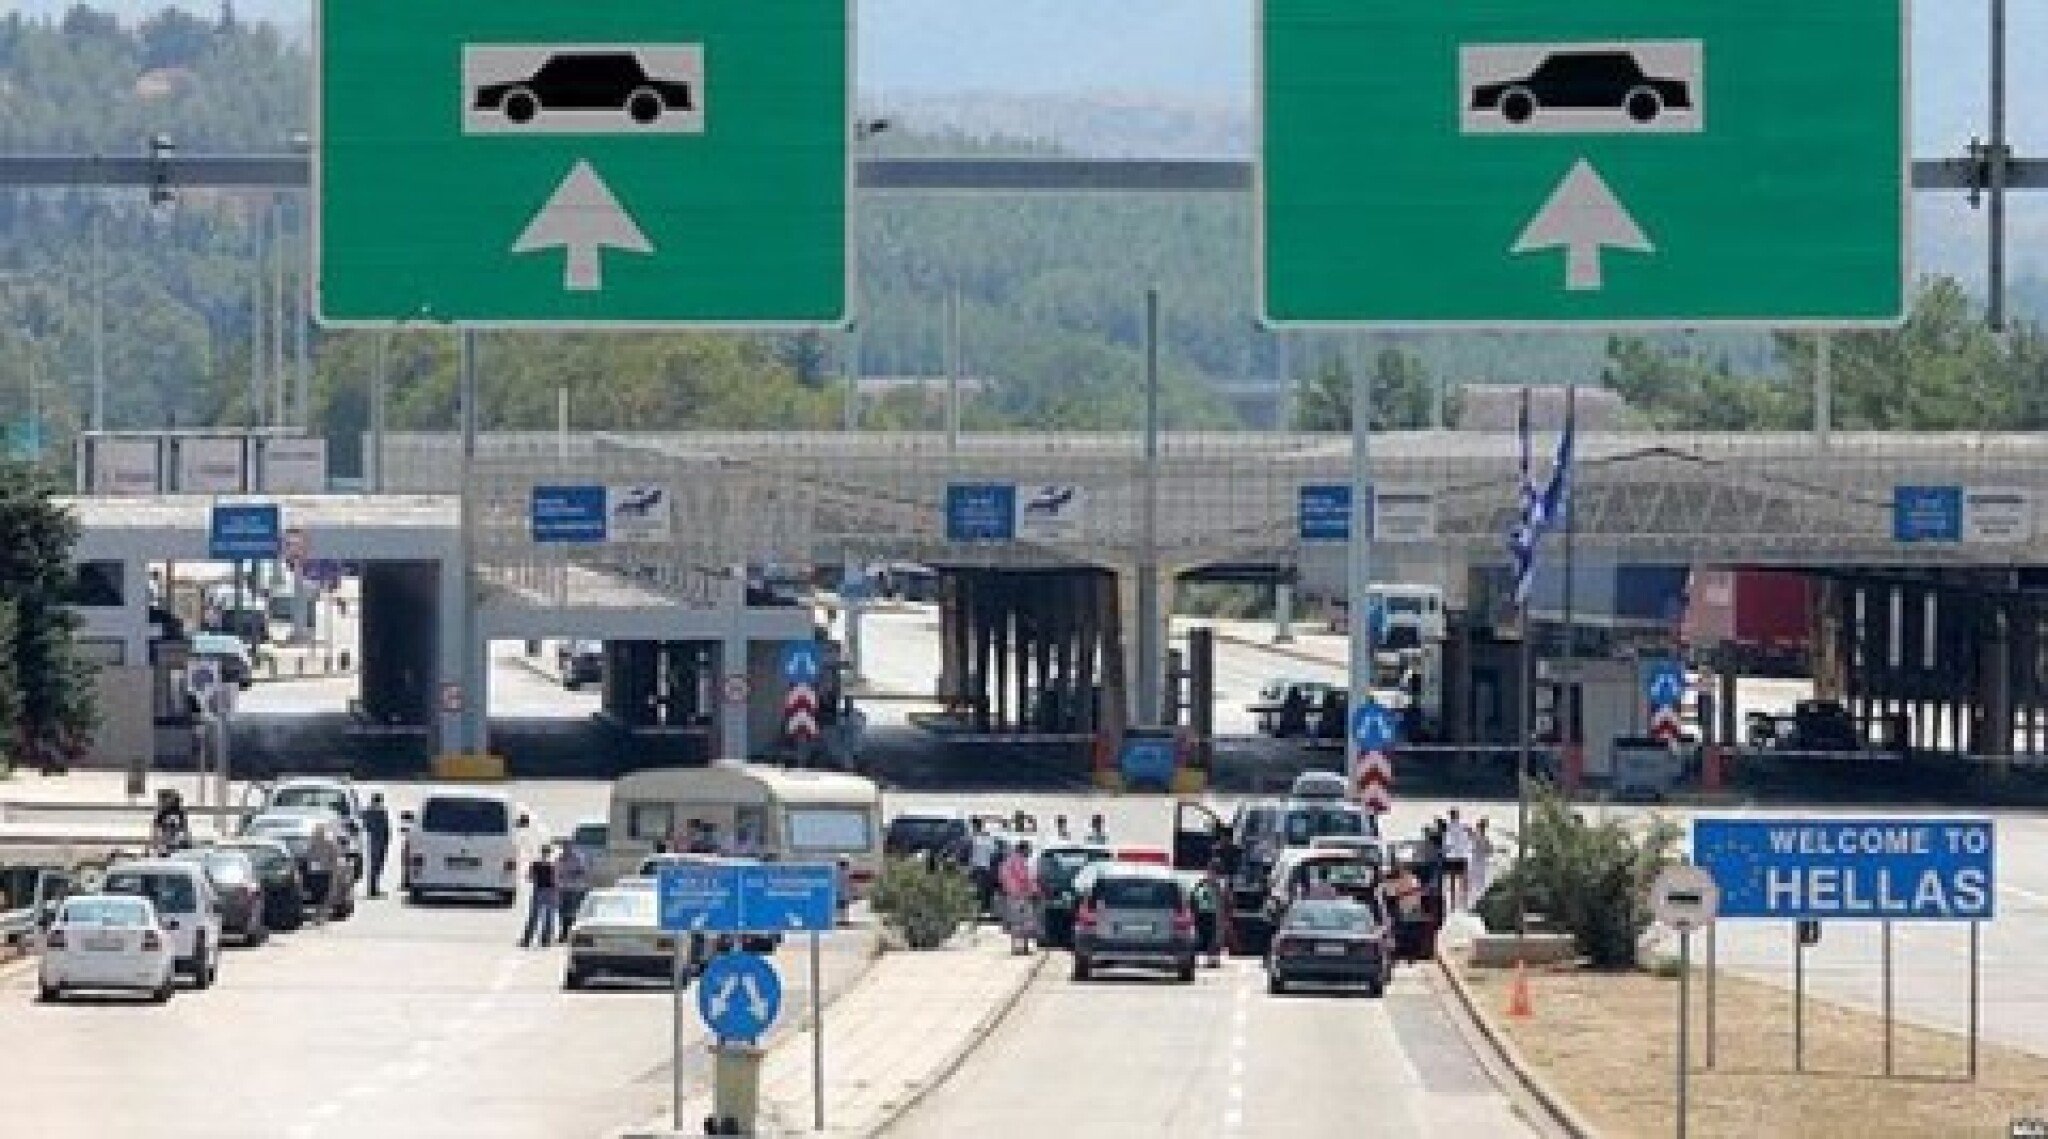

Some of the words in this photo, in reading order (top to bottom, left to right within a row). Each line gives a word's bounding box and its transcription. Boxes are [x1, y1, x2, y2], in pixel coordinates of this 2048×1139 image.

[1769, 827, 1929, 854] WELCOME
[1945, 827, 1986, 854] TO
[1766, 868, 1986, 911] HELLAS
